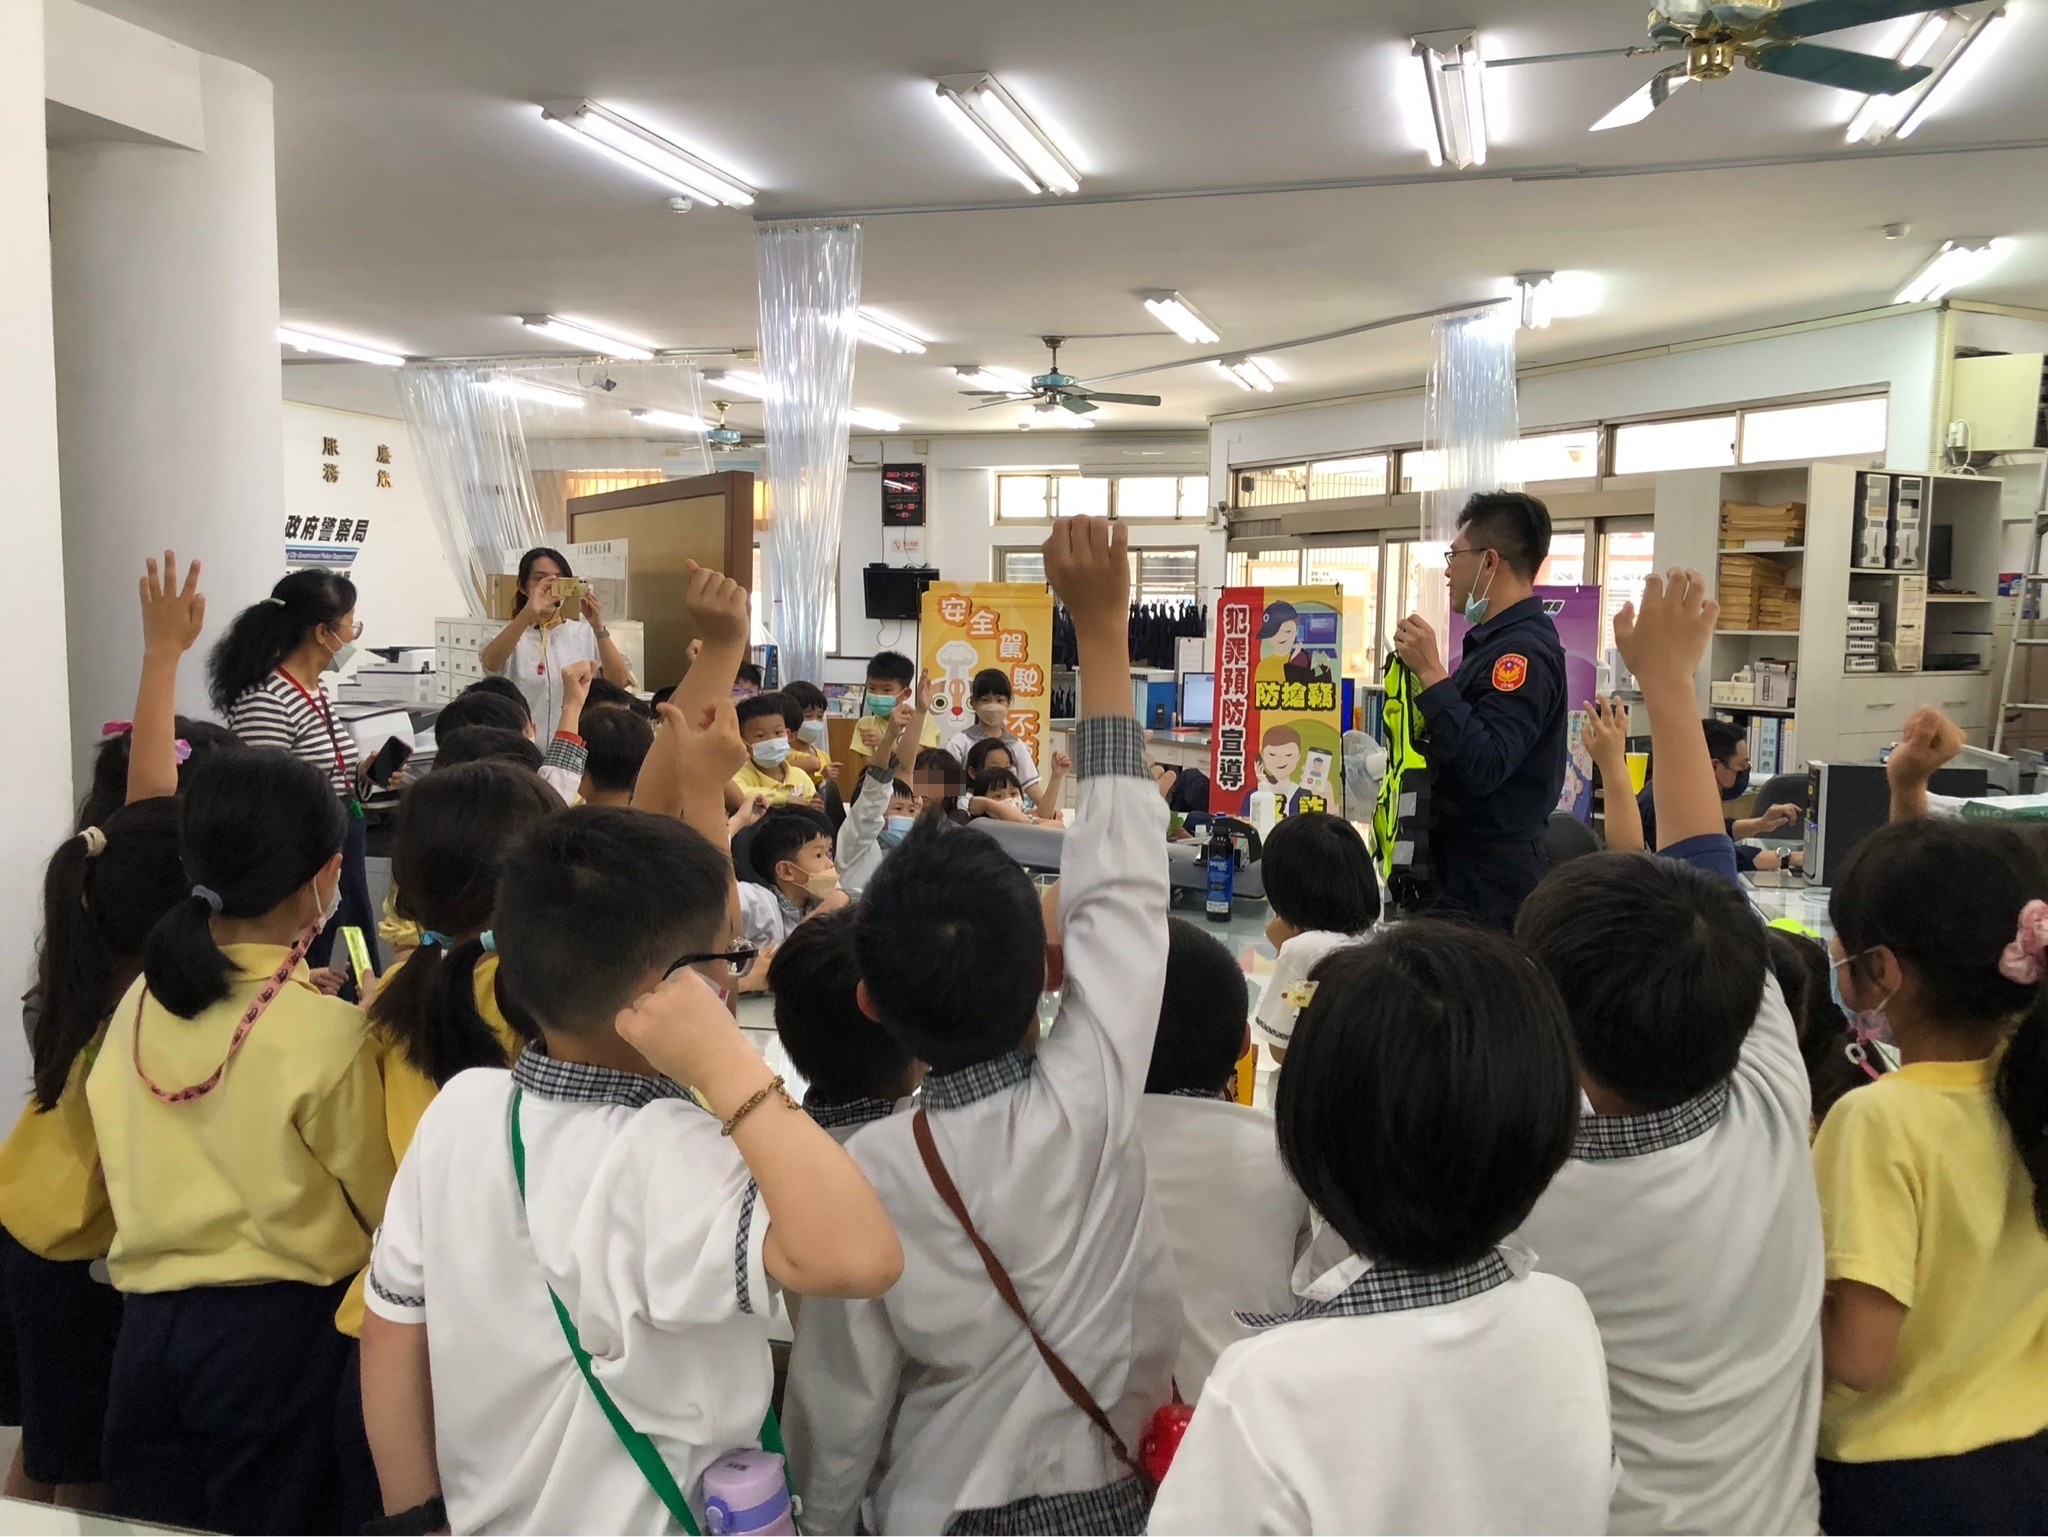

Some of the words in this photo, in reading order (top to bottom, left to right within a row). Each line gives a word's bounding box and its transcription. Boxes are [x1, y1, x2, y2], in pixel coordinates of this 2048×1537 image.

[285, 514, 370, 543] 政府警察局
[1218, 606, 1248, 789] 犯罪預防宣導
